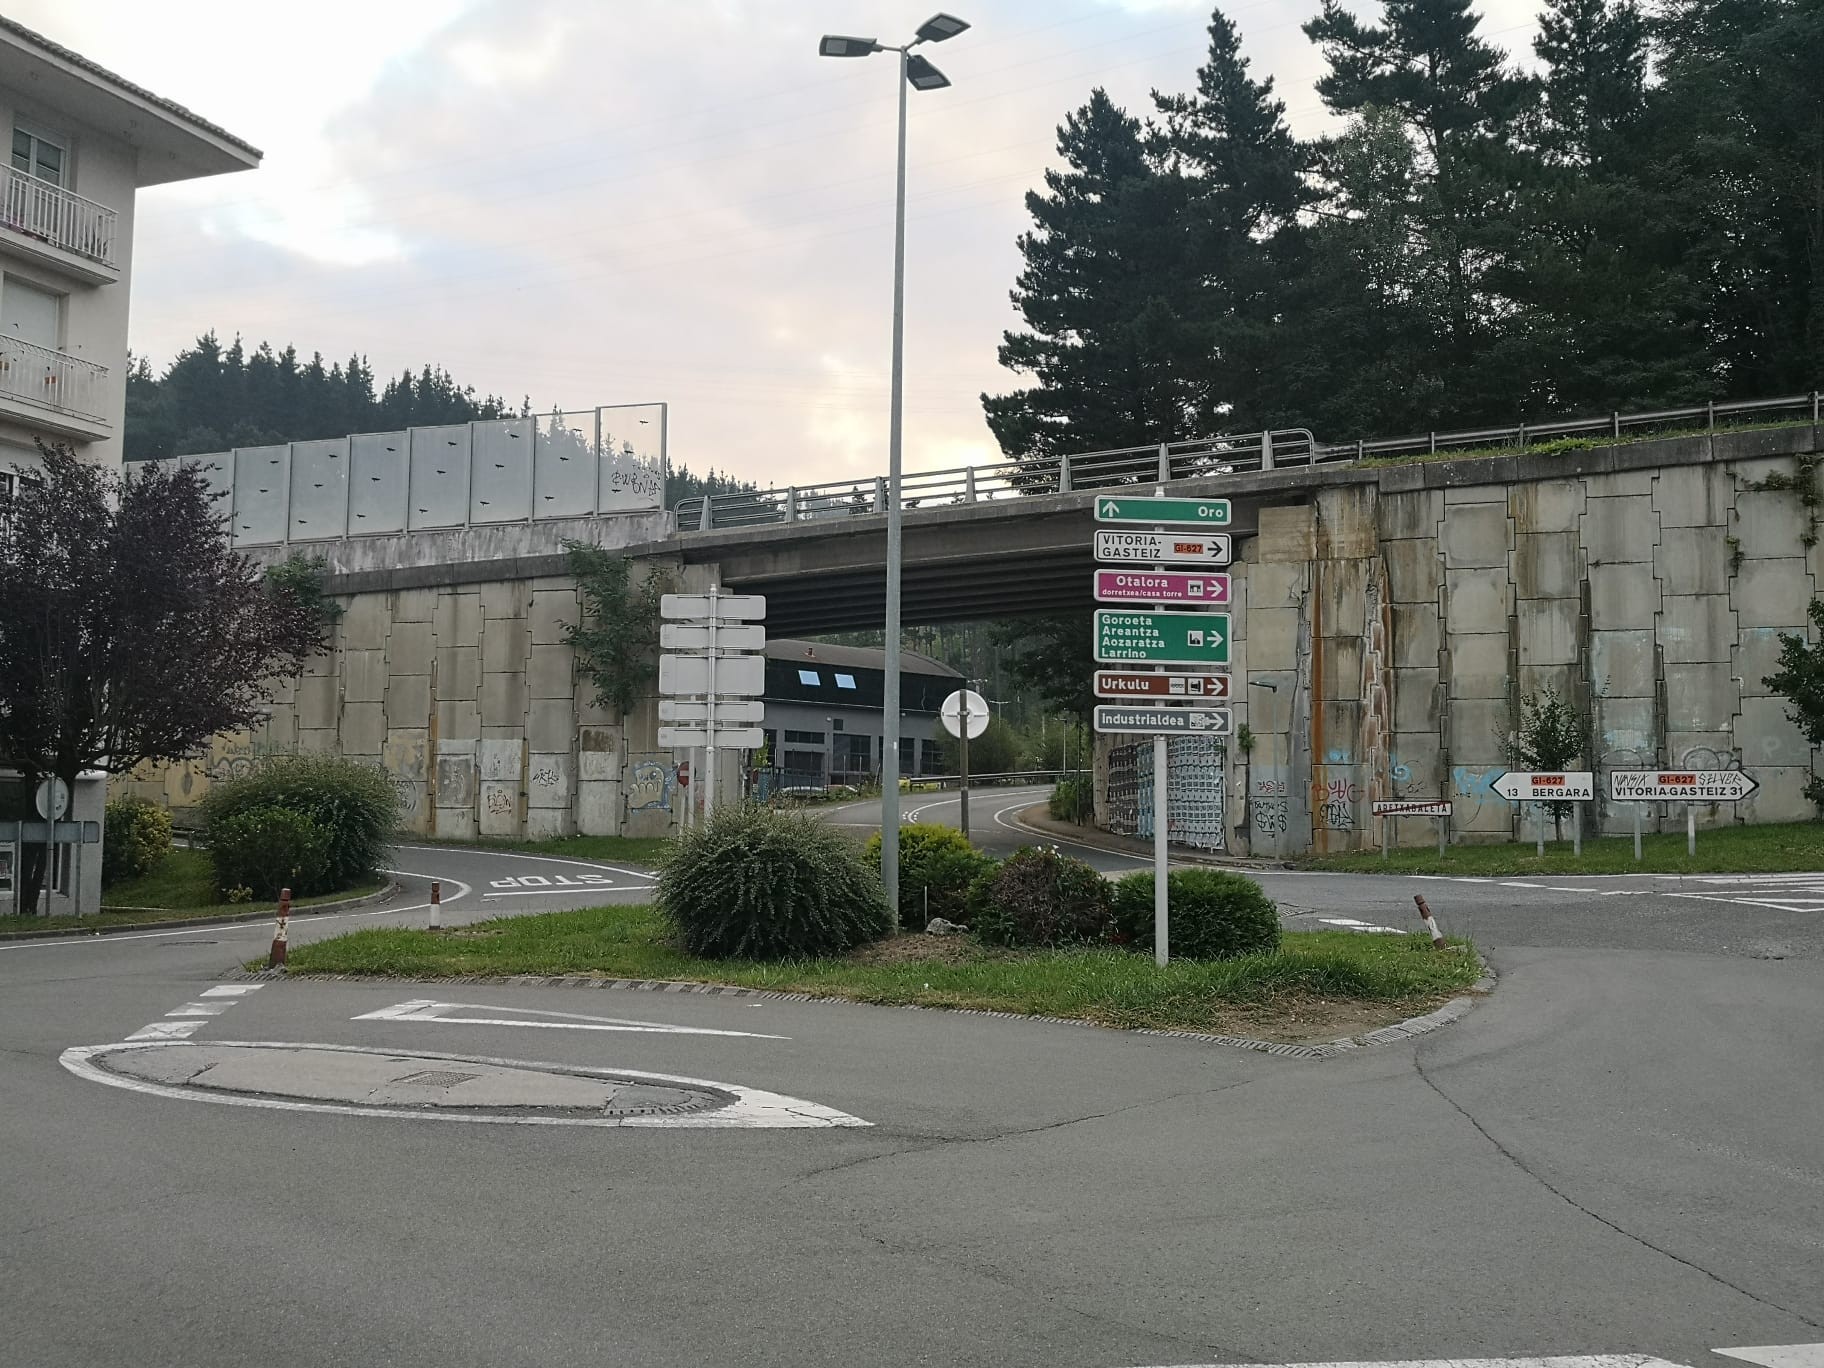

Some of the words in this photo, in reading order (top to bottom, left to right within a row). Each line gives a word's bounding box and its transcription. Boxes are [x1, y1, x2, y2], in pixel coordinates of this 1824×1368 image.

[1198, 506, 1223, 518] Oro
[1103, 535, 1162, 546] VITORIA-
[1103, 547, 1161, 559] GASTEIZ
[1175, 543, 1203, 553] GI-627
[1116, 575, 1168, 588] Otalora
[1163, 590, 1182, 598] torre
[1102, 614, 1153, 626] Goroeta
[1102, 625, 1159, 637] Areantza
[1102, 636, 1165, 648] Aozaratza
[1101, 647, 1147, 659] Larrino
[1102, 677, 1150, 690] Urkulu
[1102, 712, 1184, 726] Industrialdea
[1531, 777, 1564, 786] GI-627
[1658, 775, 1695, 785] GI-627
[1507, 788, 1519, 797] 13
[1532, 788, 1590, 797] BERGARA
[1730, 786, 1743, 796] 31
[489, 874, 614, 888] STOP
